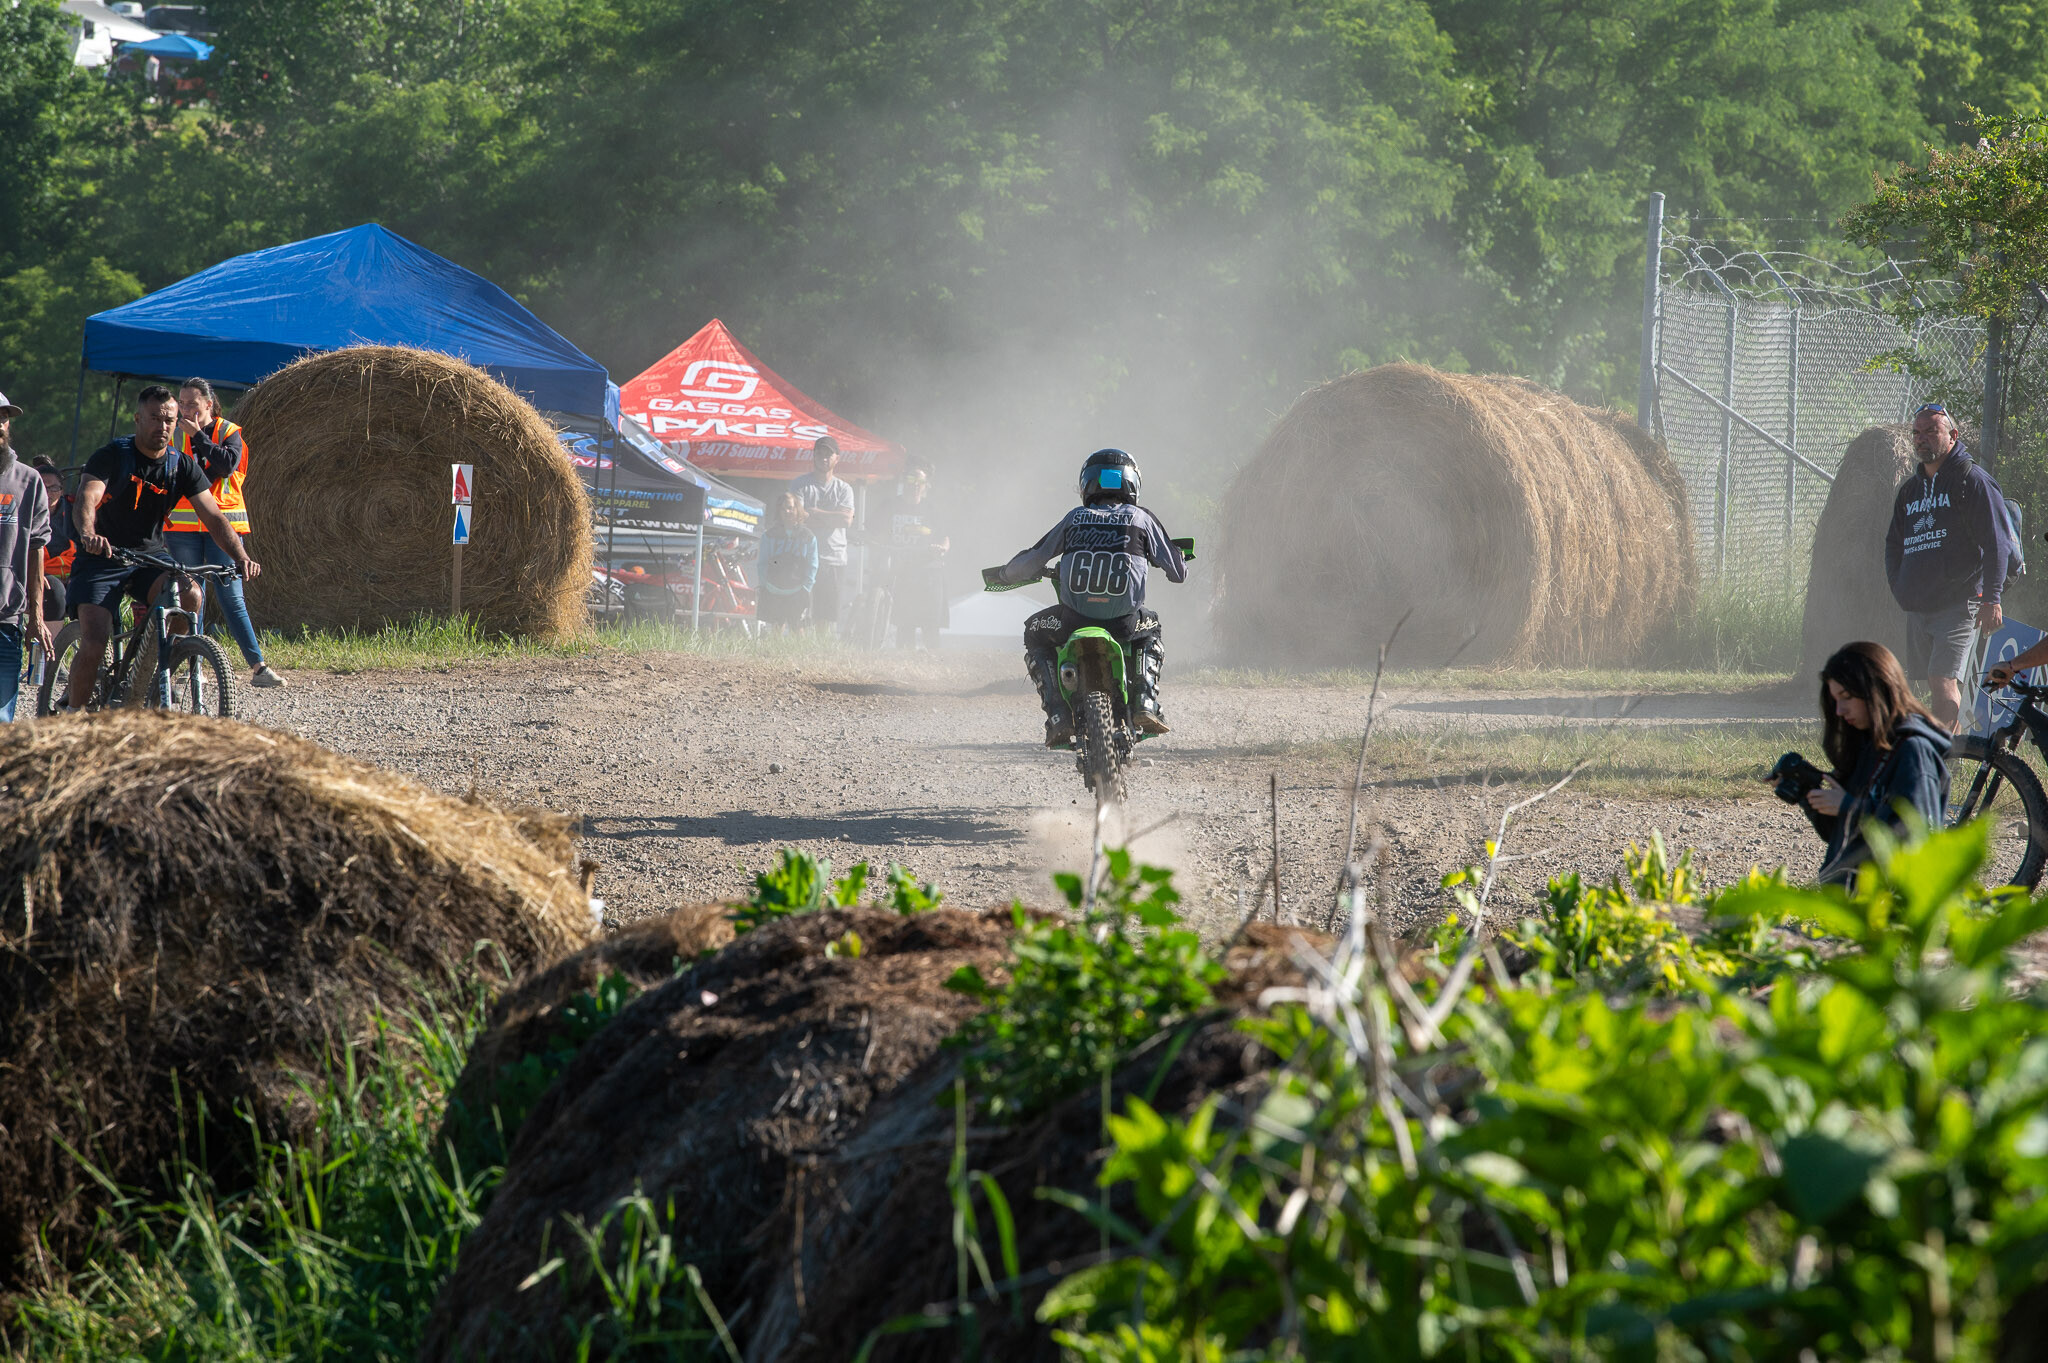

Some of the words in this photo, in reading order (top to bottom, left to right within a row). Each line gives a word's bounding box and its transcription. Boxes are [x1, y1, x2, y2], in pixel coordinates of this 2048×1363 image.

[648, 398, 792, 419] GASGAS
[697, 442, 730, 457] 3477
[728, 443, 769, 460] South
[770, 446, 787, 460] St.
[627, 491, 684, 502] PRINTING
[1069, 550, 1132, 596] 608
